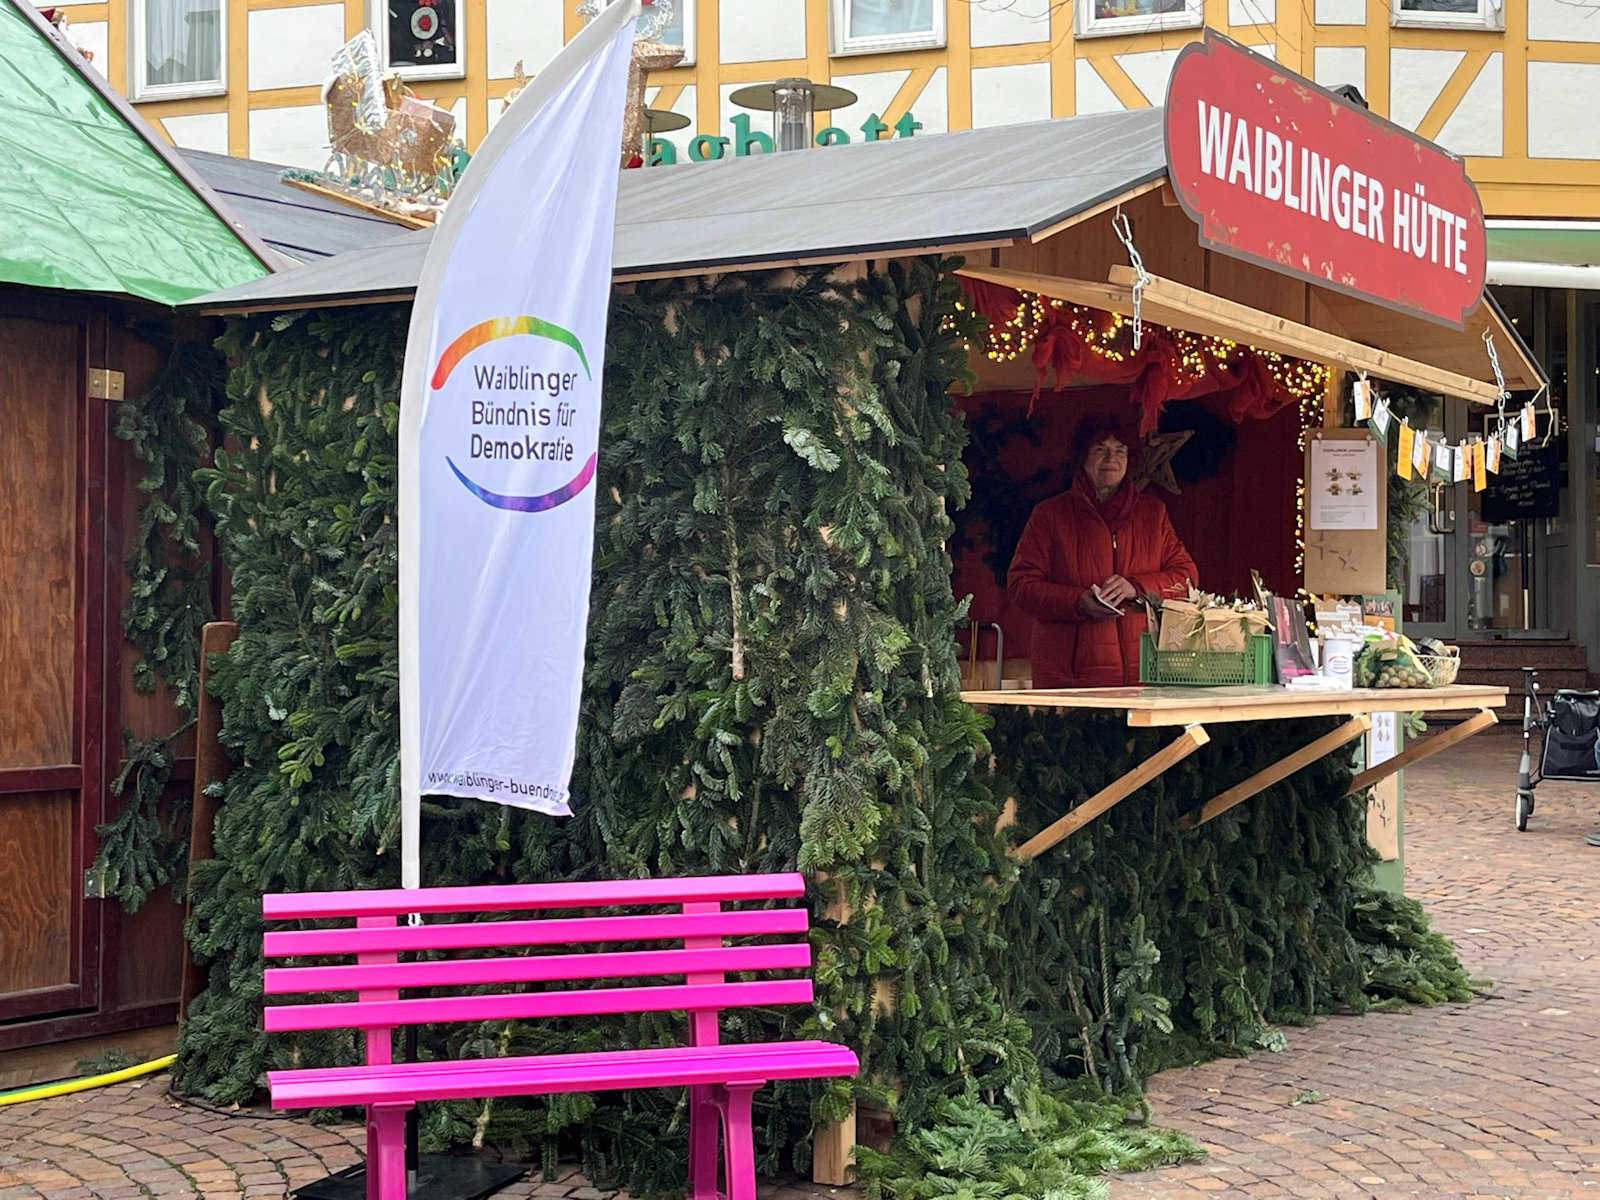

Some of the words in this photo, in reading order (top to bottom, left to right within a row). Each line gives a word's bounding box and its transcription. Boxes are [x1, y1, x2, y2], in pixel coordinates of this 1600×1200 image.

[1197, 99, 1385, 243] WAIBLINGER
[1393, 182, 1467, 275] HÜTTE
[473, 364, 578, 397] Waiblinger
[471, 400, 551, 426] Bündnis
[556, 401, 576, 427] für
[470, 433, 574, 461] Demokratie
